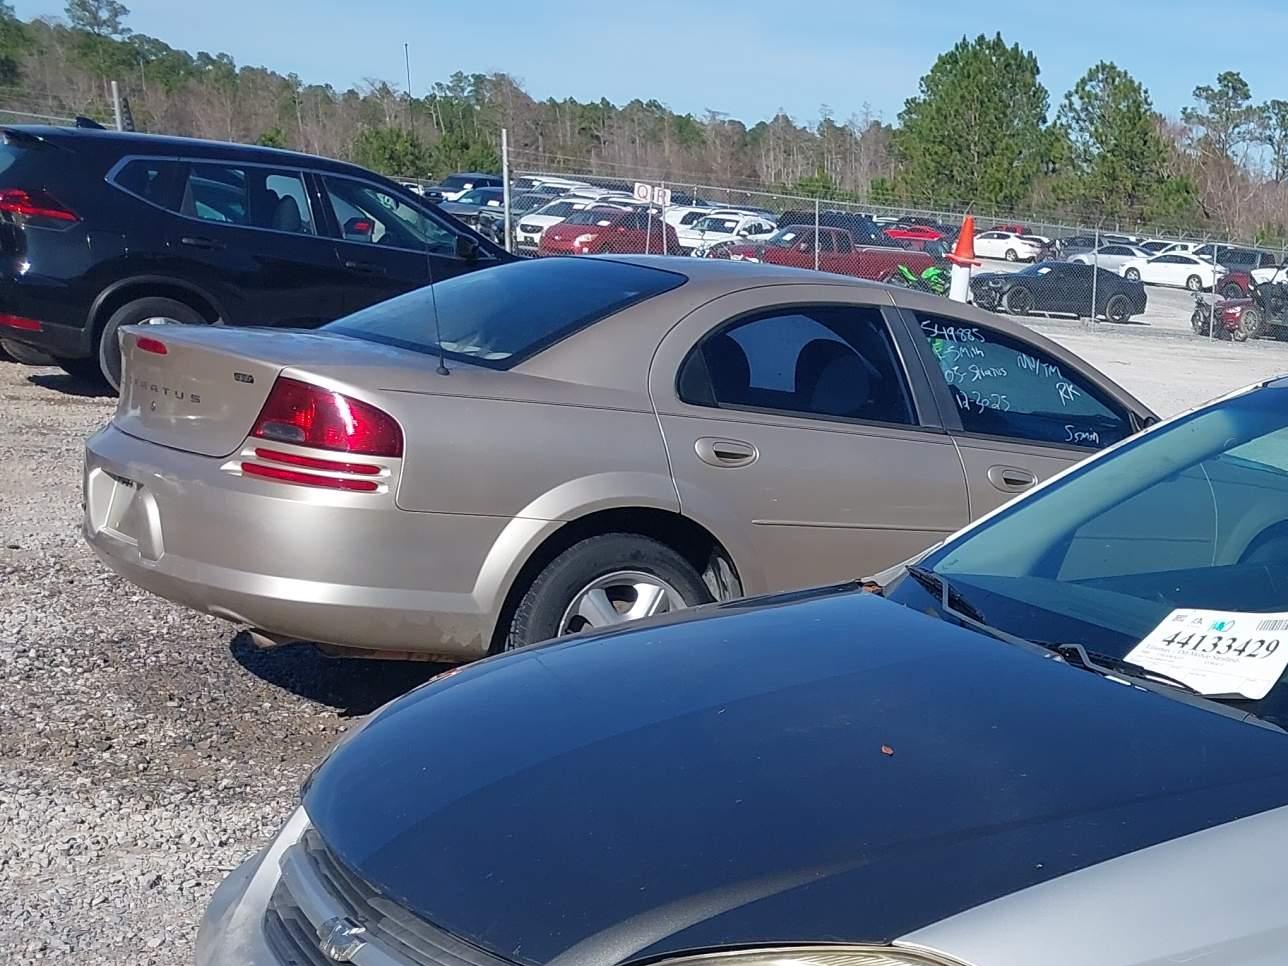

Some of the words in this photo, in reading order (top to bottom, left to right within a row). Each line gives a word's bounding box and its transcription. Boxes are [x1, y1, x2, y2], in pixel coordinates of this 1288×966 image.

[657, 188, 667, 204] R
[129, 375, 201, 403] TRATUS
[1161, 630, 1281, 660] 44133429
